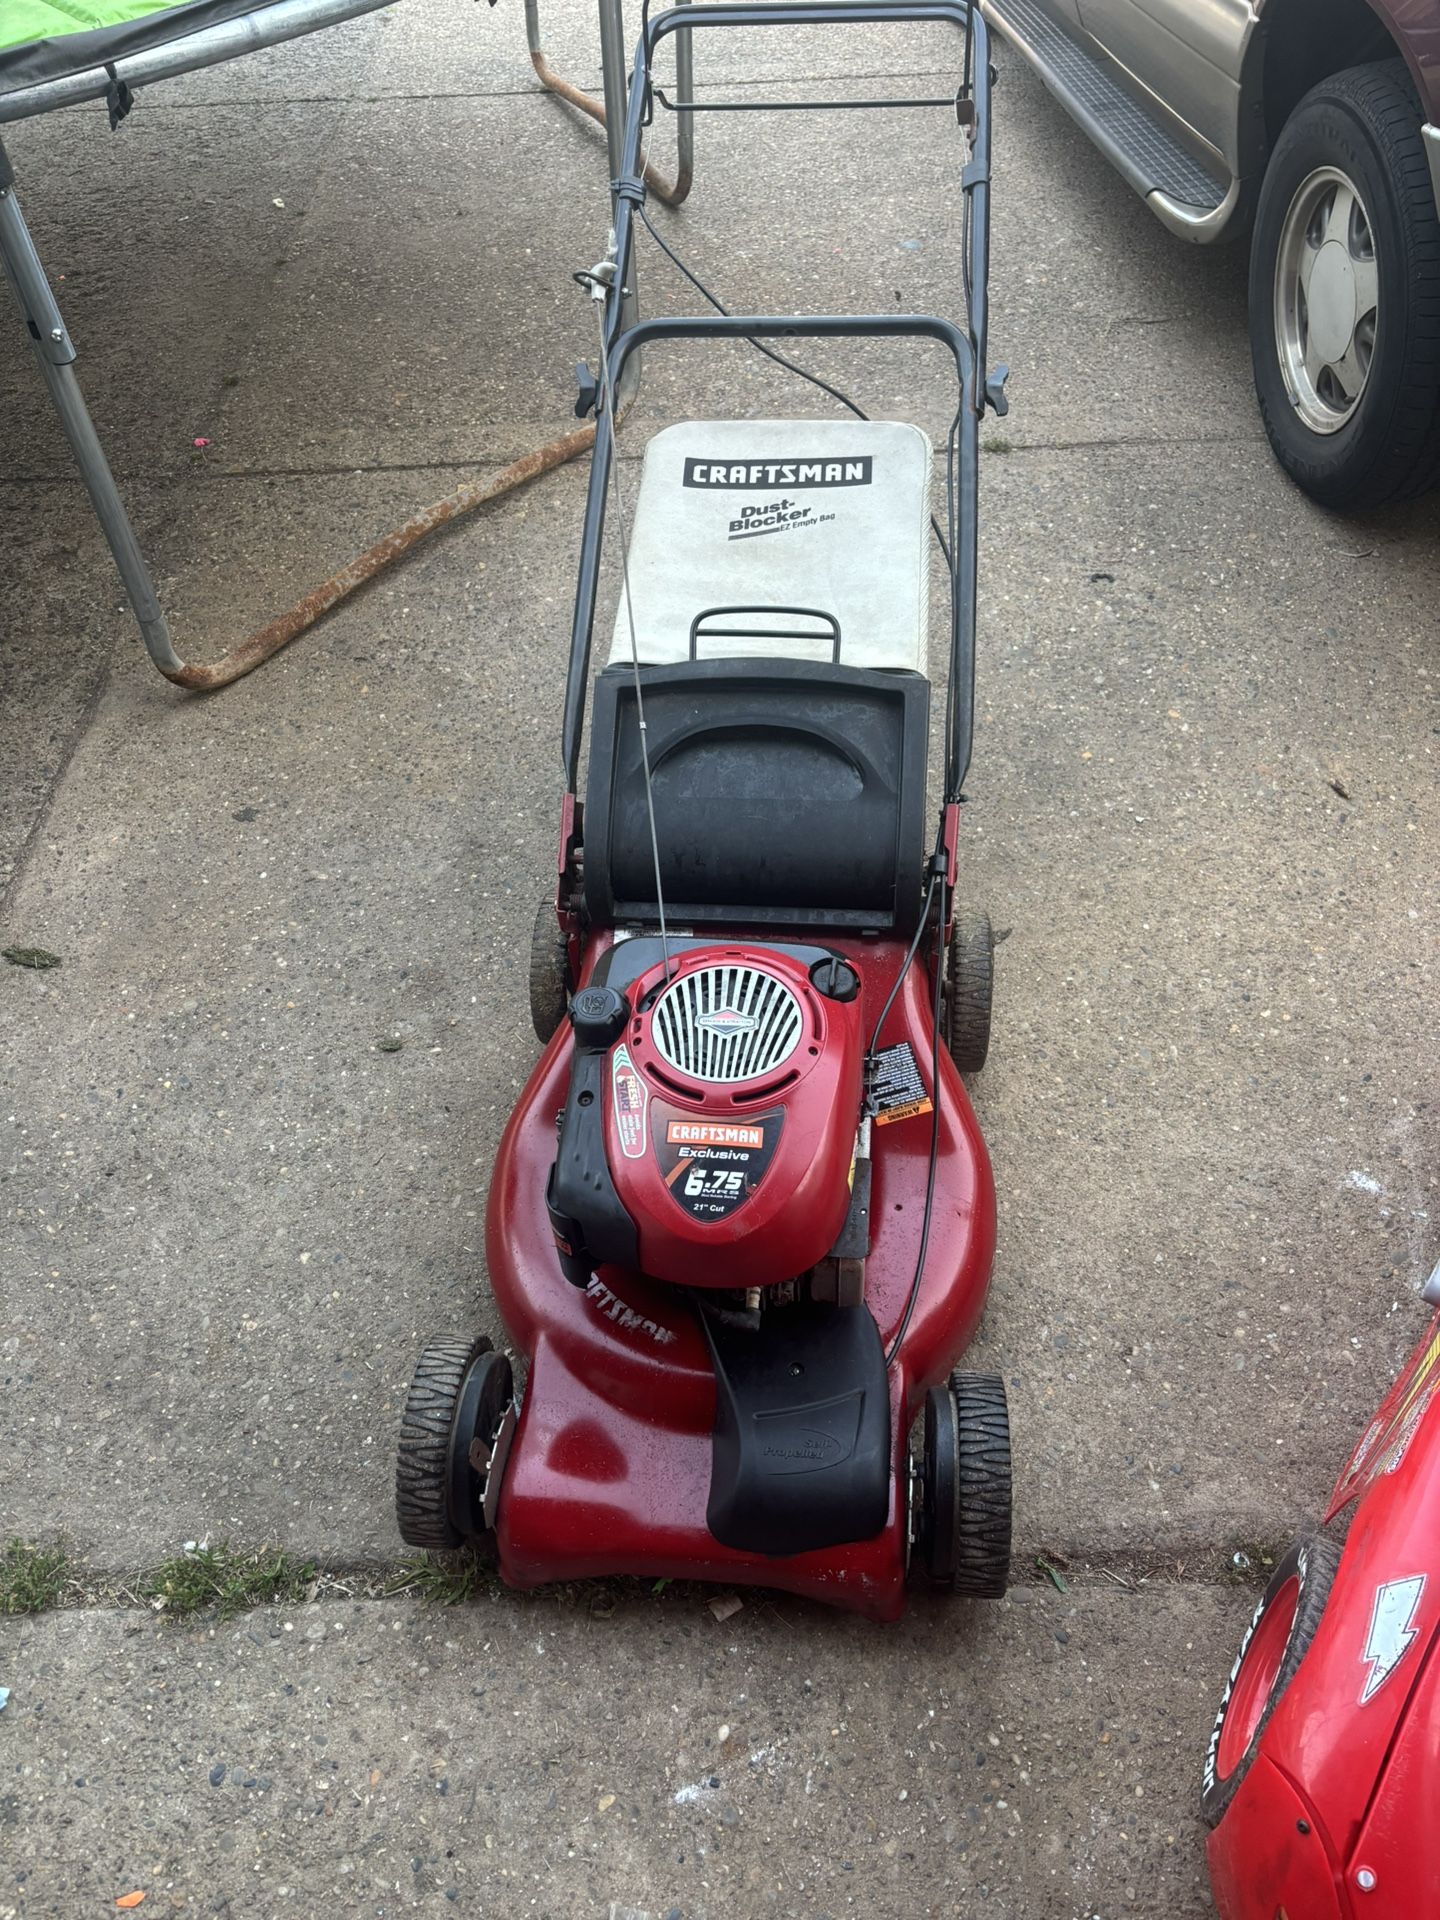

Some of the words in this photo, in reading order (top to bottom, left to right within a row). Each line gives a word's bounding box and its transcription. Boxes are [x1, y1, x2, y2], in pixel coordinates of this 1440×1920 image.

[692, 462, 864, 484] CRAFTSMAN
[740, 499, 796, 519] Dust-
[729, 507, 812, 533] Blocker
[780, 523, 791, 532] EZ
[792, 517, 818, 529] Empty
[819, 513, 836, 522] Bag
[619, 1080, 632, 1113] START
[627, 1075, 640, 1109] FRESH
[671, 1125, 759, 1144] CRAFTSMAN
[678, 1146, 750, 1161] Exclusive
[684, 1169, 745, 1196] 6.75
[709, 1204, 725, 1212] Cut
